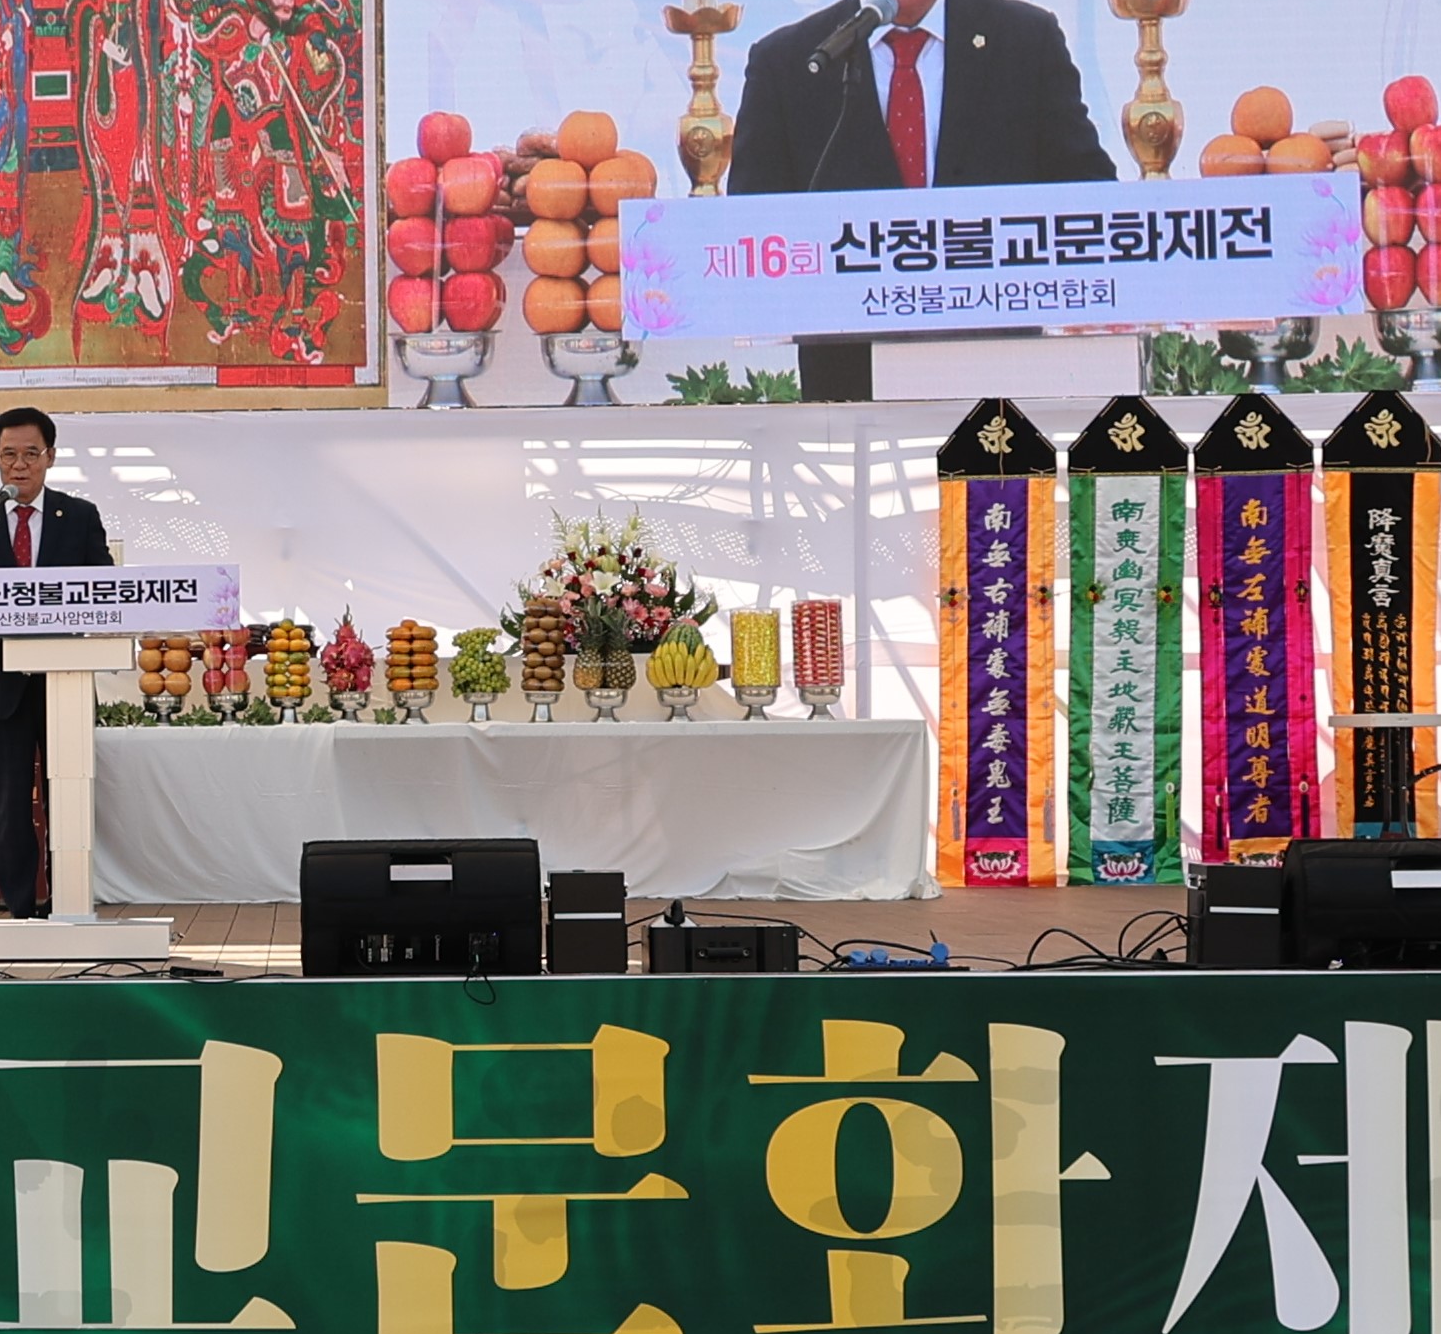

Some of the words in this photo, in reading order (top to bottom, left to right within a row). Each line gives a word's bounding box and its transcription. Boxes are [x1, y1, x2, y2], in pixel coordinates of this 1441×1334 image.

[705, 235, 820, 277] 제16회
[831, 207, 1272, 273] 산청불교문화제전
[863, 276, 1116, 315] 산청불교사암연합회
[0, 610, 122, 627] 산청불교사암연합회
